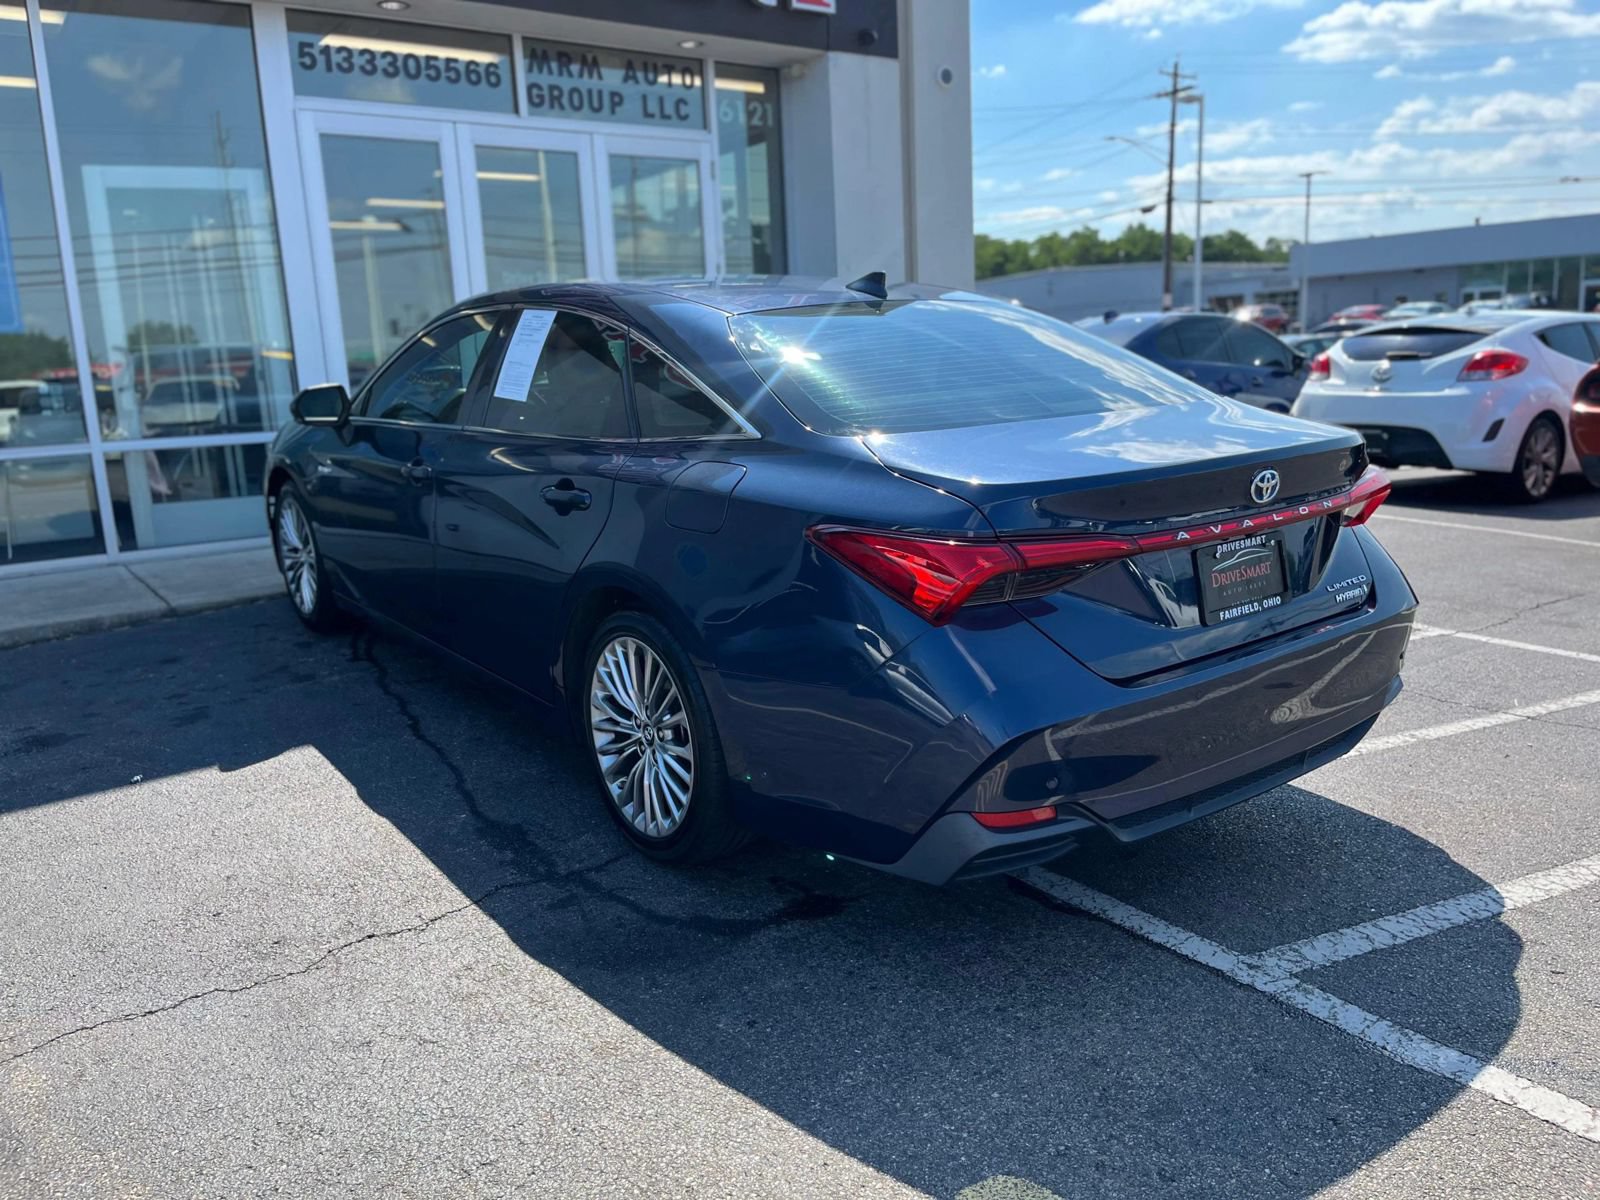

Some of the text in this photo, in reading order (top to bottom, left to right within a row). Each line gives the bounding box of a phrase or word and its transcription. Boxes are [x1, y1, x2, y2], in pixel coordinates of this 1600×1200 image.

[297, 41, 502, 89] 5133305566
[527, 48, 697, 90] MRM AUTO
[526, 82, 691, 122] GROUP LLC
[718, 98, 774, 128] 6121
[1176, 500, 1333, 541] AVALON
[1216, 535, 1267, 554] DRIVESMART
[1326, 574, 1367, 592] LIMITED
[1335, 587, 1364, 604] HYBRID
[1219, 601, 1262, 621] FAIRFIELD,
[1263, 596, 1282, 608] OHIO
